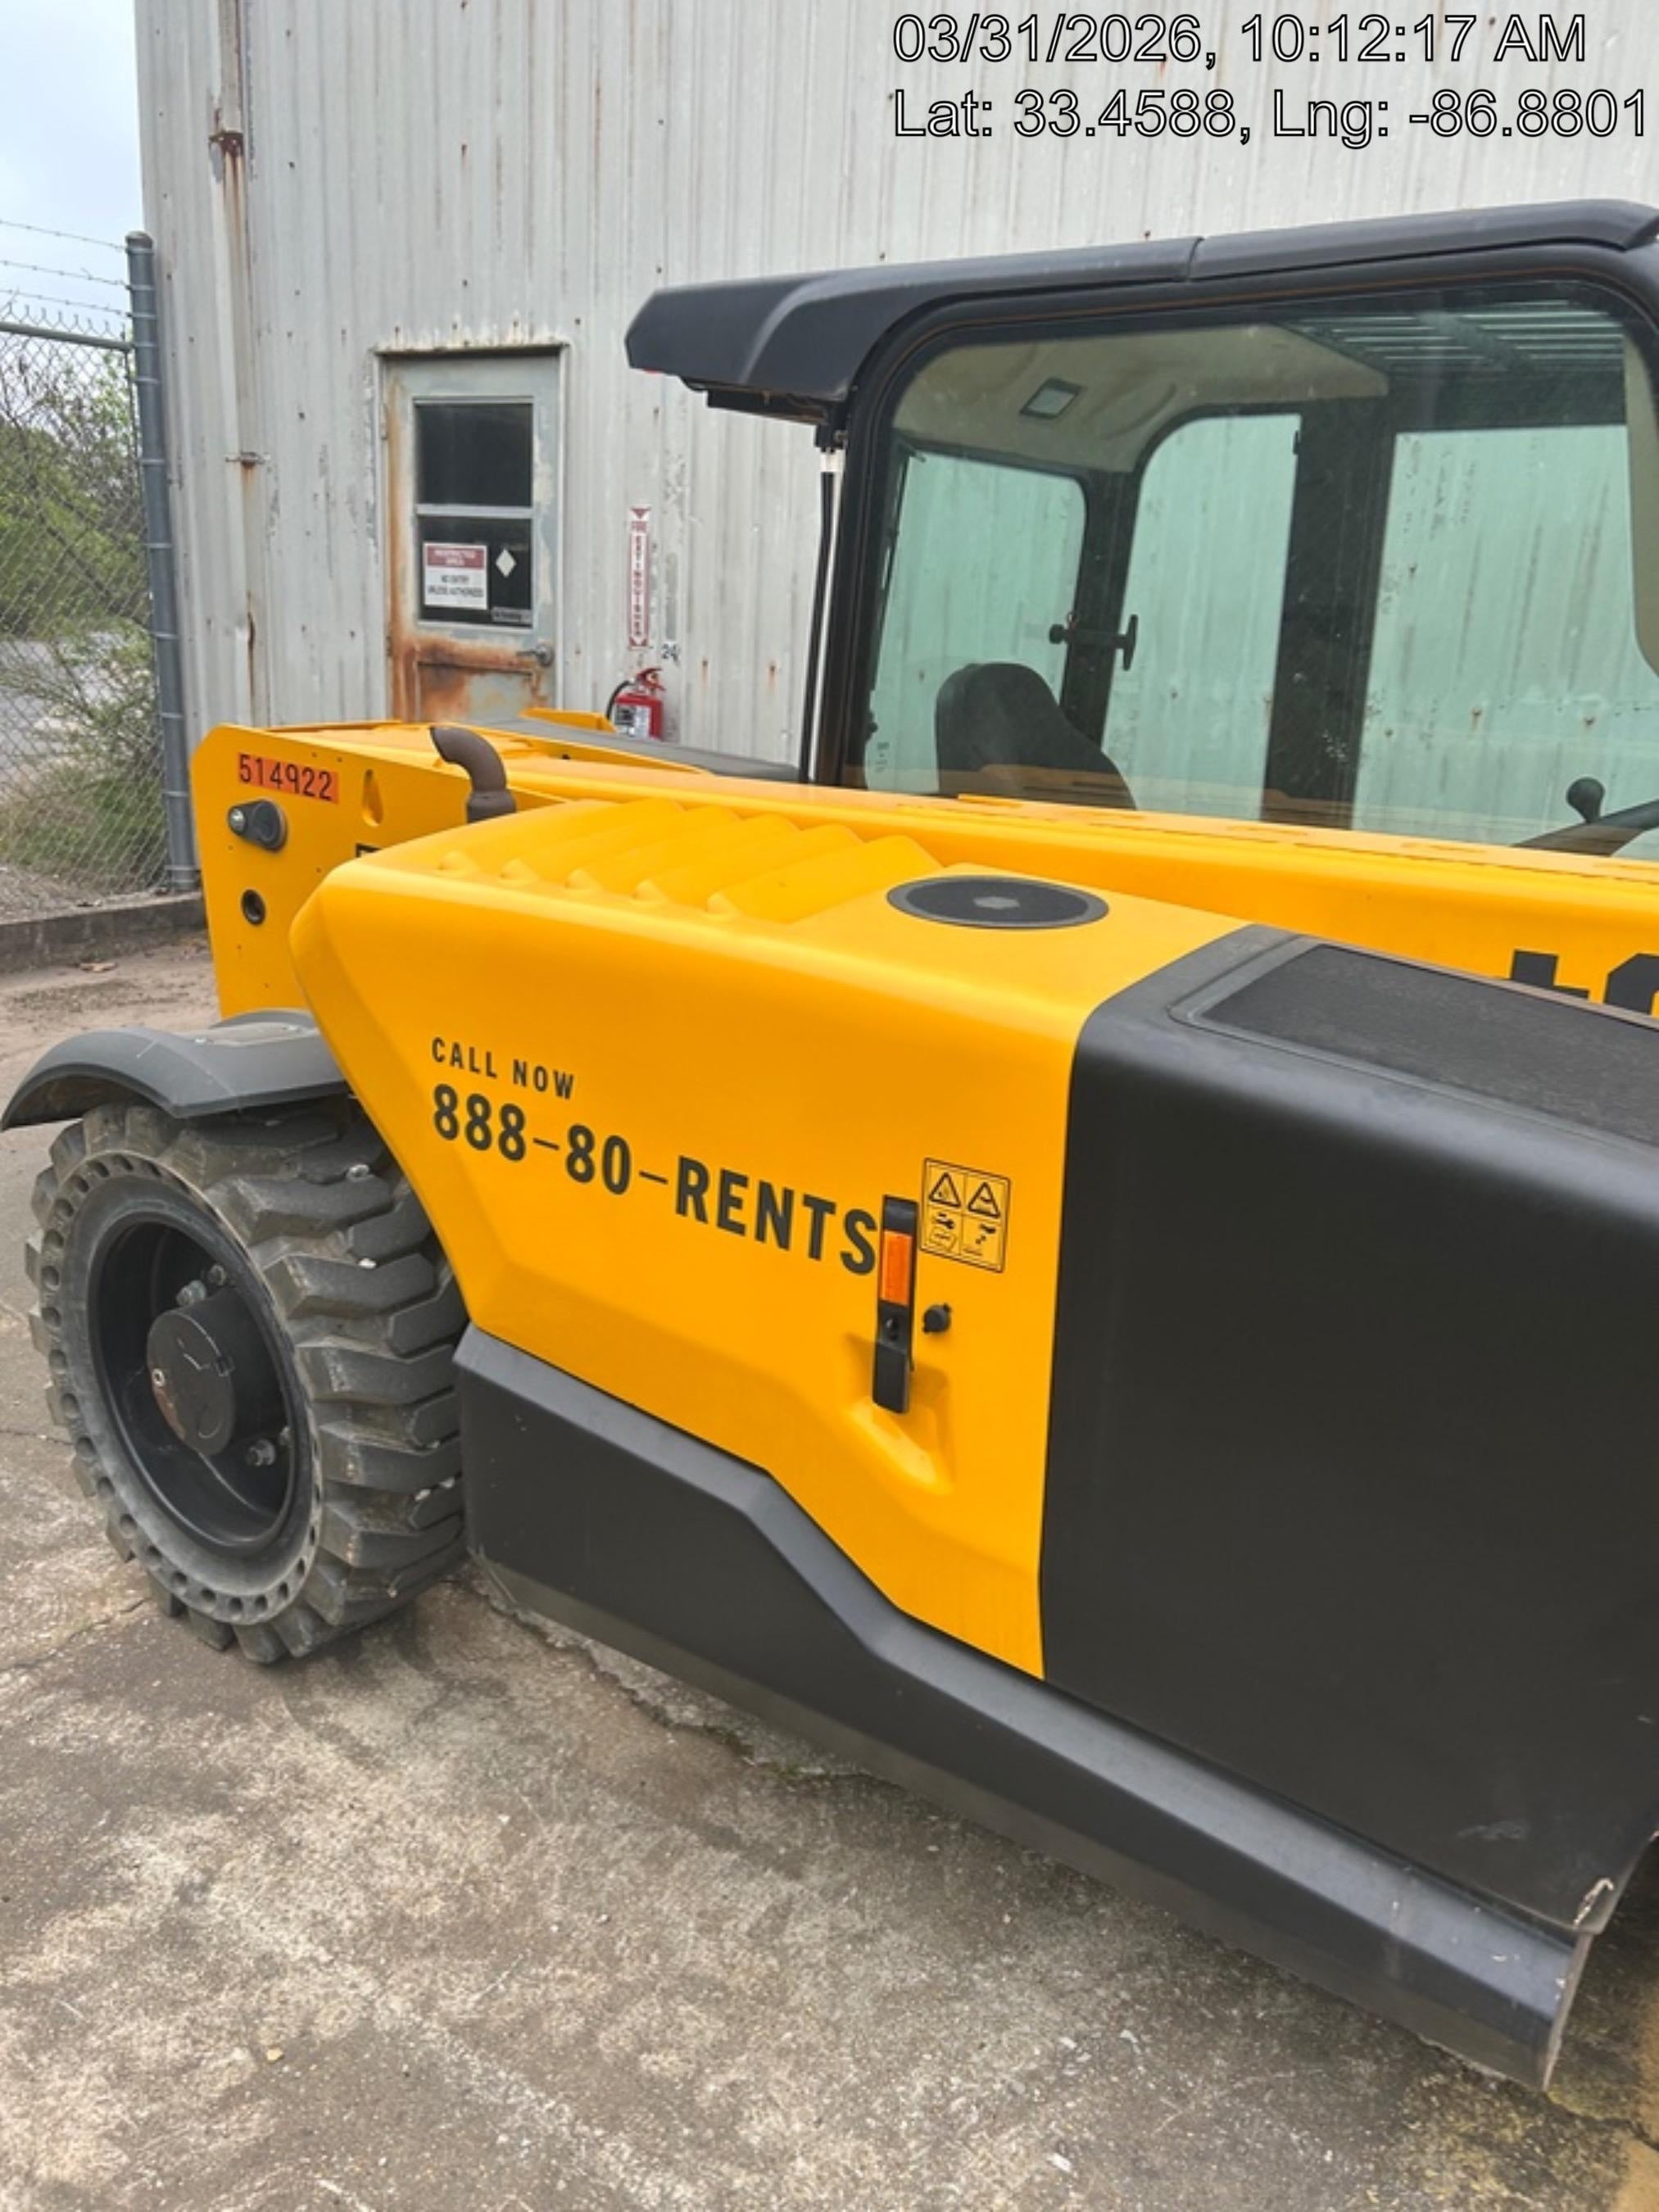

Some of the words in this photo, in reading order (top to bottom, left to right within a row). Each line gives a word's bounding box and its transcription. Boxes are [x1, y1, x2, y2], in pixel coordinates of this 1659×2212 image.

[238, 753, 333, 802] 514922
[432, 1036, 497, 1078] CALL
[513, 1058, 574, 1099] NOW
[433, 1083, 878, 1276] 888-80-RENTS
